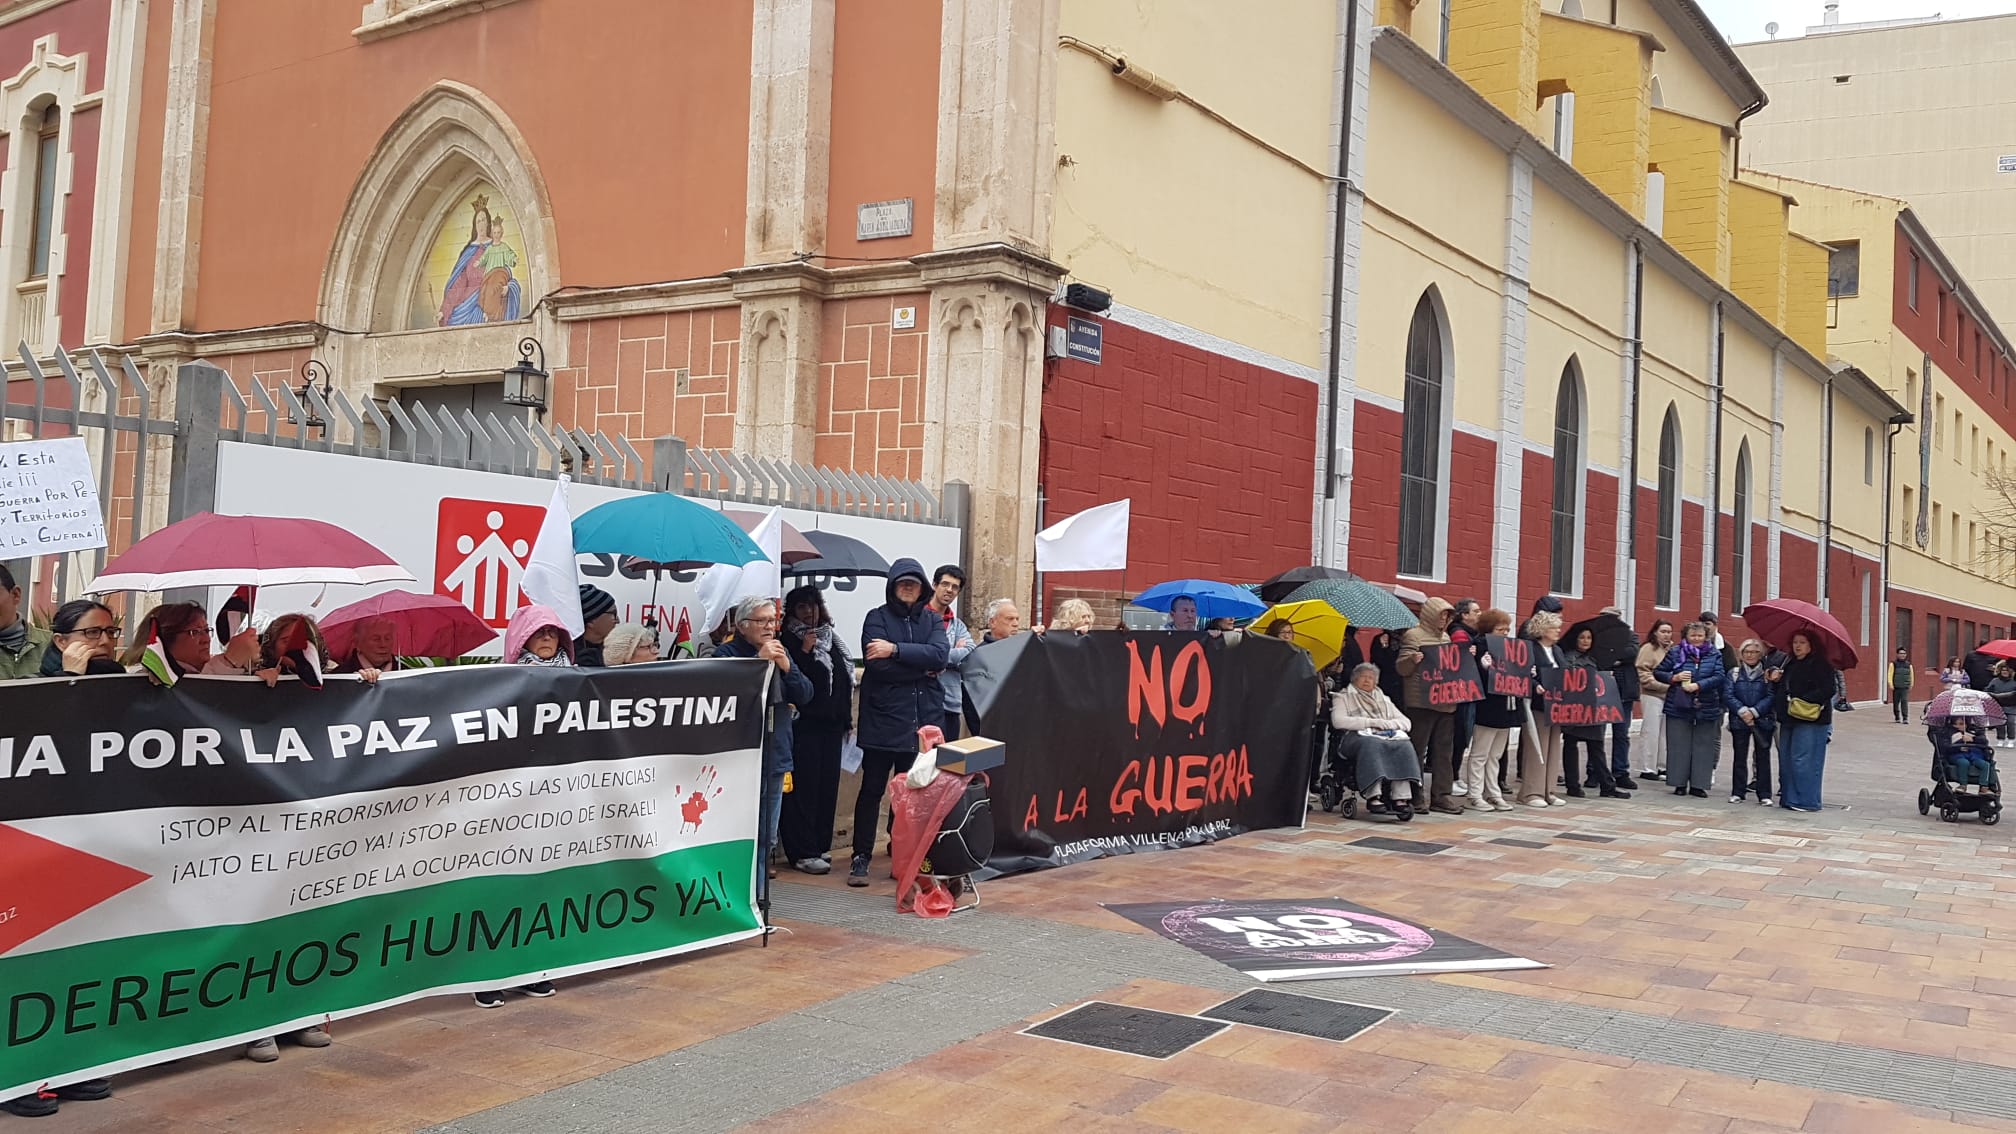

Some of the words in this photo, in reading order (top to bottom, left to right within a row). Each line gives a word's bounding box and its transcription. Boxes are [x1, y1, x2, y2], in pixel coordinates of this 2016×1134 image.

[1079, 325, 1098, 337] AVENIDA
[1438, 643, 1461, 672] NO
[1504, 637, 1528, 667] NO
[1125, 639, 1212, 739] NO
[1429, 679, 1482, 705] GUERRA
[1494, 672, 1531, 697] GUERRA
[1563, 667, 1588, 693] NO
[1550, 702, 1593, 725] GUERRA
[90, 728, 225, 773] POR
[239, 727, 313, 763] LA
[327, 716, 438, 759] PAZ
[450, 706, 519, 745] EN
[532, 695, 738, 735] PALESTINA
[1023, 794, 1039, 832] A
[1054, 786, 1088, 824] LA
[1110, 744, 1254, 816] GUERRA
[160, 816, 232, 845] ¡STOP
[239, 814, 271, 834] AL
[280, 799, 420, 832] TERRORISMO
[422, 793, 437, 809] Y
[438, 790, 451, 805] A
[457, 781, 523, 802] TODAS
[529, 777, 562, 796] LAS
[566, 766, 657, 792] VIOLENCIAS!
[172, 854, 242, 884] ¡ALTO
[251, 853, 279, 873] EL
[286, 838, 358, 870] FUEGO
[364, 830, 394, 854] YA!
[398, 822, 457, 850] ¡STOP
[463, 809, 573, 837] GENOCIDIO
[578, 805, 596, 823] DE
[600, 799, 657, 820] ISRAEL!
[1054, 834, 1131, 857] PLATAFORMA
[1130, 830, 1185, 847] VILLENA
[1215, 818, 1231, 831] PAZ
[289, 875, 347, 906] ¡CESE
[353, 869, 378, 890] DE
[384, 863, 406, 884] LA
[412, 844, 534, 877] OCUPACIÓN
[540, 843, 562, 863] DE
[567, 831, 659, 859] PALESTINA!
[1199, 914, 1353, 933] NO
[1248, 935, 1408, 949] GUERRA
[7, 931, 361, 1048] DERECHOS
[379, 884, 658, 967] HUMANOS
[675, 870, 732, 917] YA!
